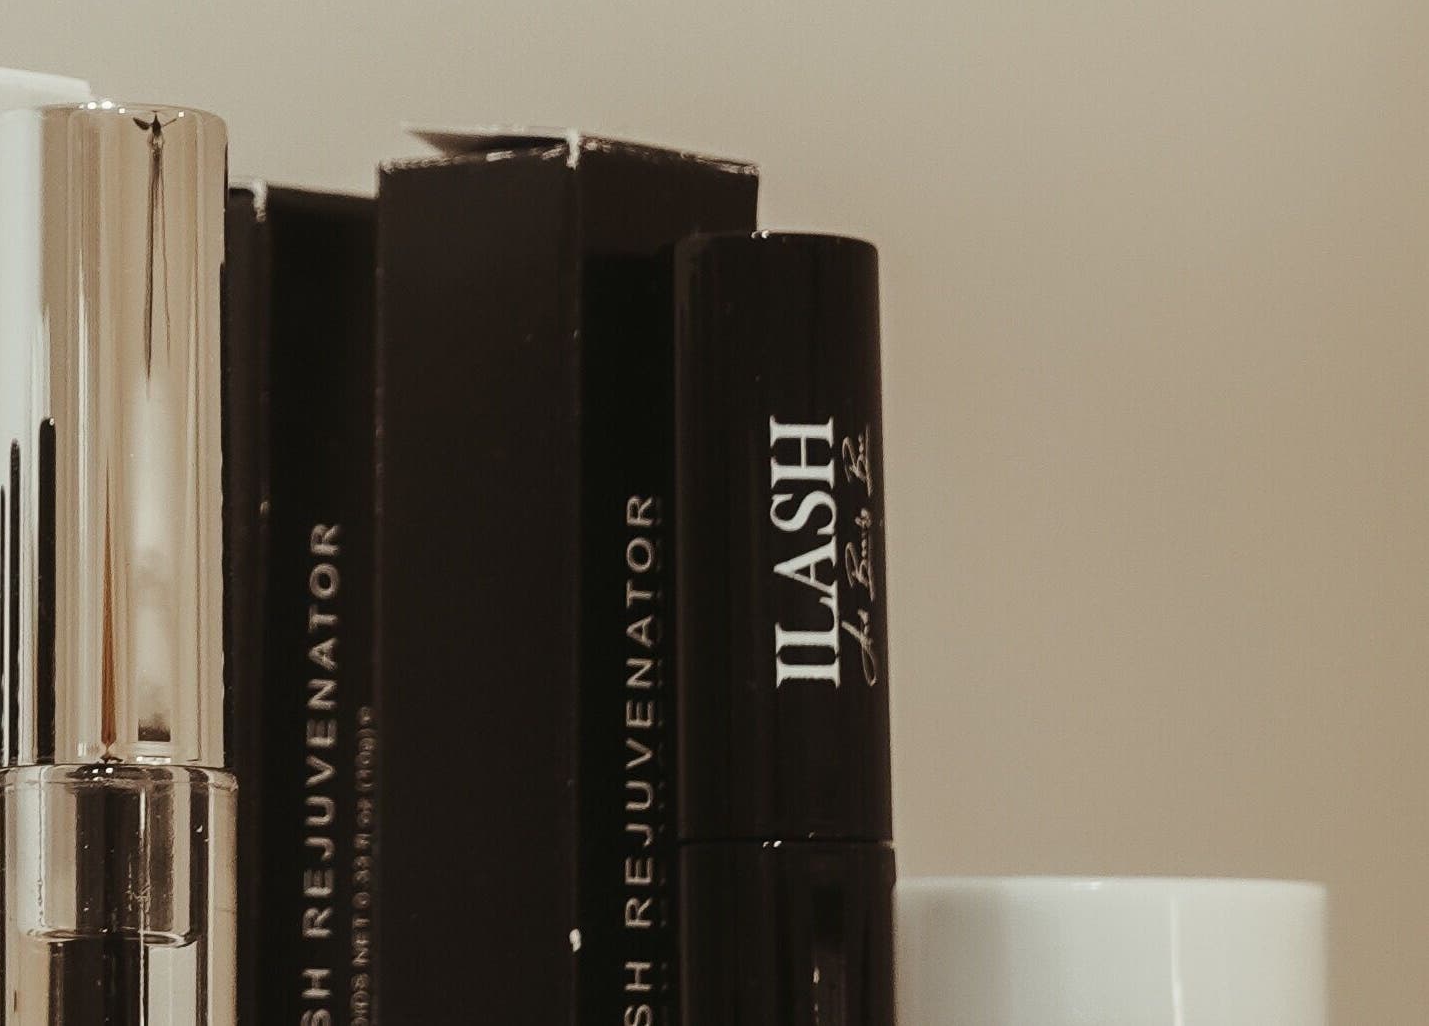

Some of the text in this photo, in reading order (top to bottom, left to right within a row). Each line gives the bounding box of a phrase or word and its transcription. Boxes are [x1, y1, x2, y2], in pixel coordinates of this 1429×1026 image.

[301, 522, 341, 938] REJUVENATOR
[624, 494, 654, 929] REJUVENATOR
[769, 415, 840, 689] ILASH
